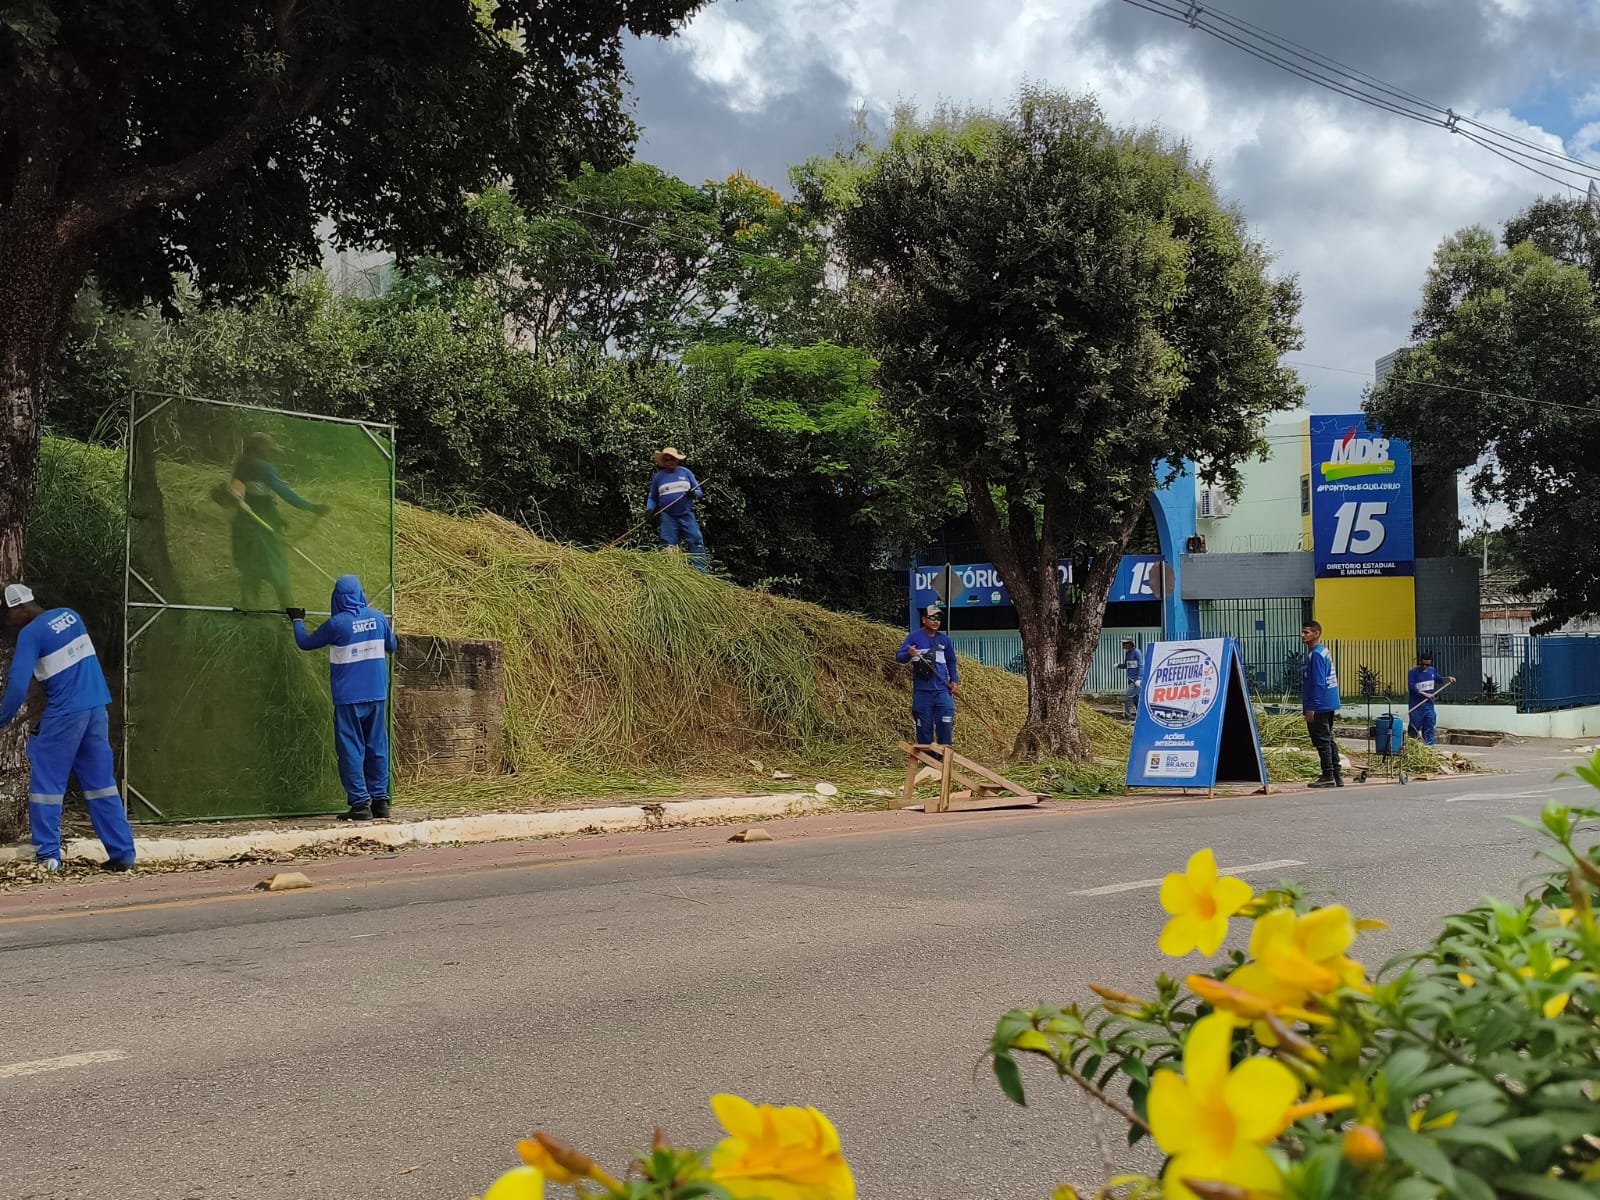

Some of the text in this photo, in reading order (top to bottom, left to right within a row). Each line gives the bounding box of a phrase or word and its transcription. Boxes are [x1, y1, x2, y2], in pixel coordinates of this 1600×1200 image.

[1330, 437, 1390, 465] MDB
[1331, 502, 1388, 554] 15
[1326, 563, 1361, 571] DIRETÓRIO
[1155, 664, 1203, 684] PREFEITURA
[1153, 683, 1202, 703] RUAS
[1163, 732, 1186, 740] AÇÕES
